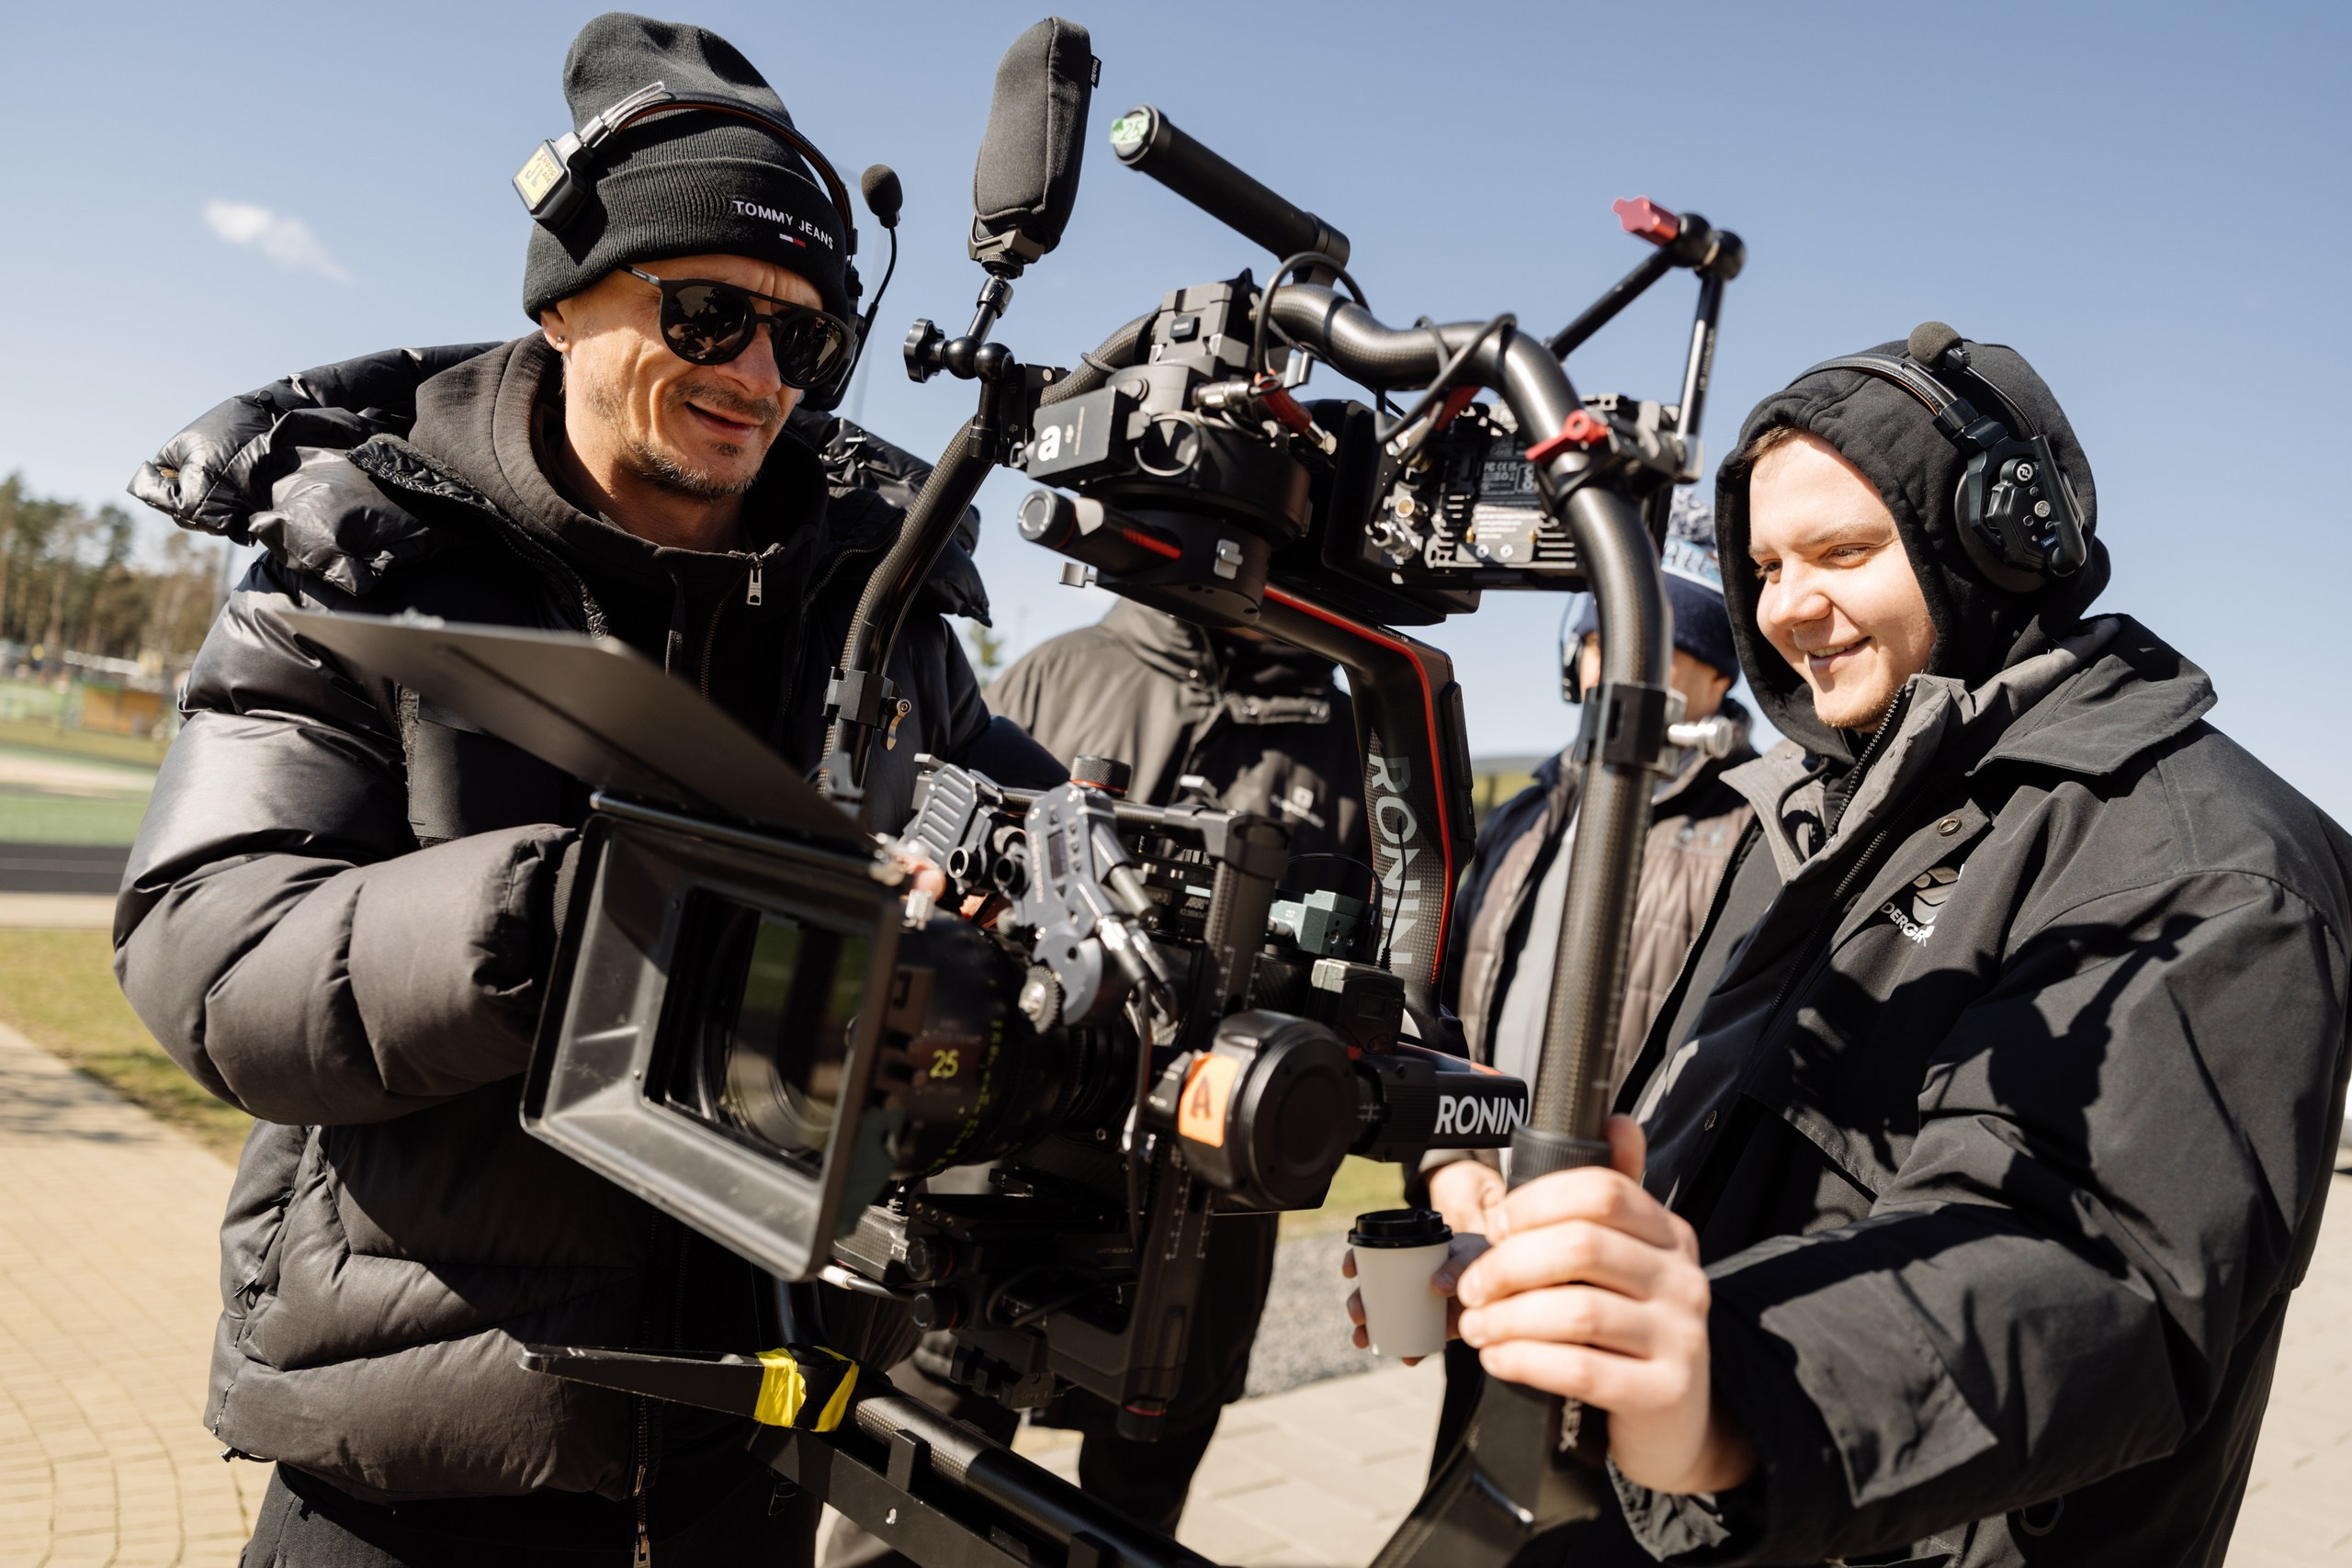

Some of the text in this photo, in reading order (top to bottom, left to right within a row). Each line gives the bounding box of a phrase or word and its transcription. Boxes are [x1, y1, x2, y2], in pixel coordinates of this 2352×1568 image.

[732, 200, 833, 250] TOMMY JEANS
[1368, 753, 1419, 964] RONIN
[930, 1049, 960, 1079] 25
[1190, 1074, 1212, 1120] A
[1433, 1095, 1525, 1134] RONIN
